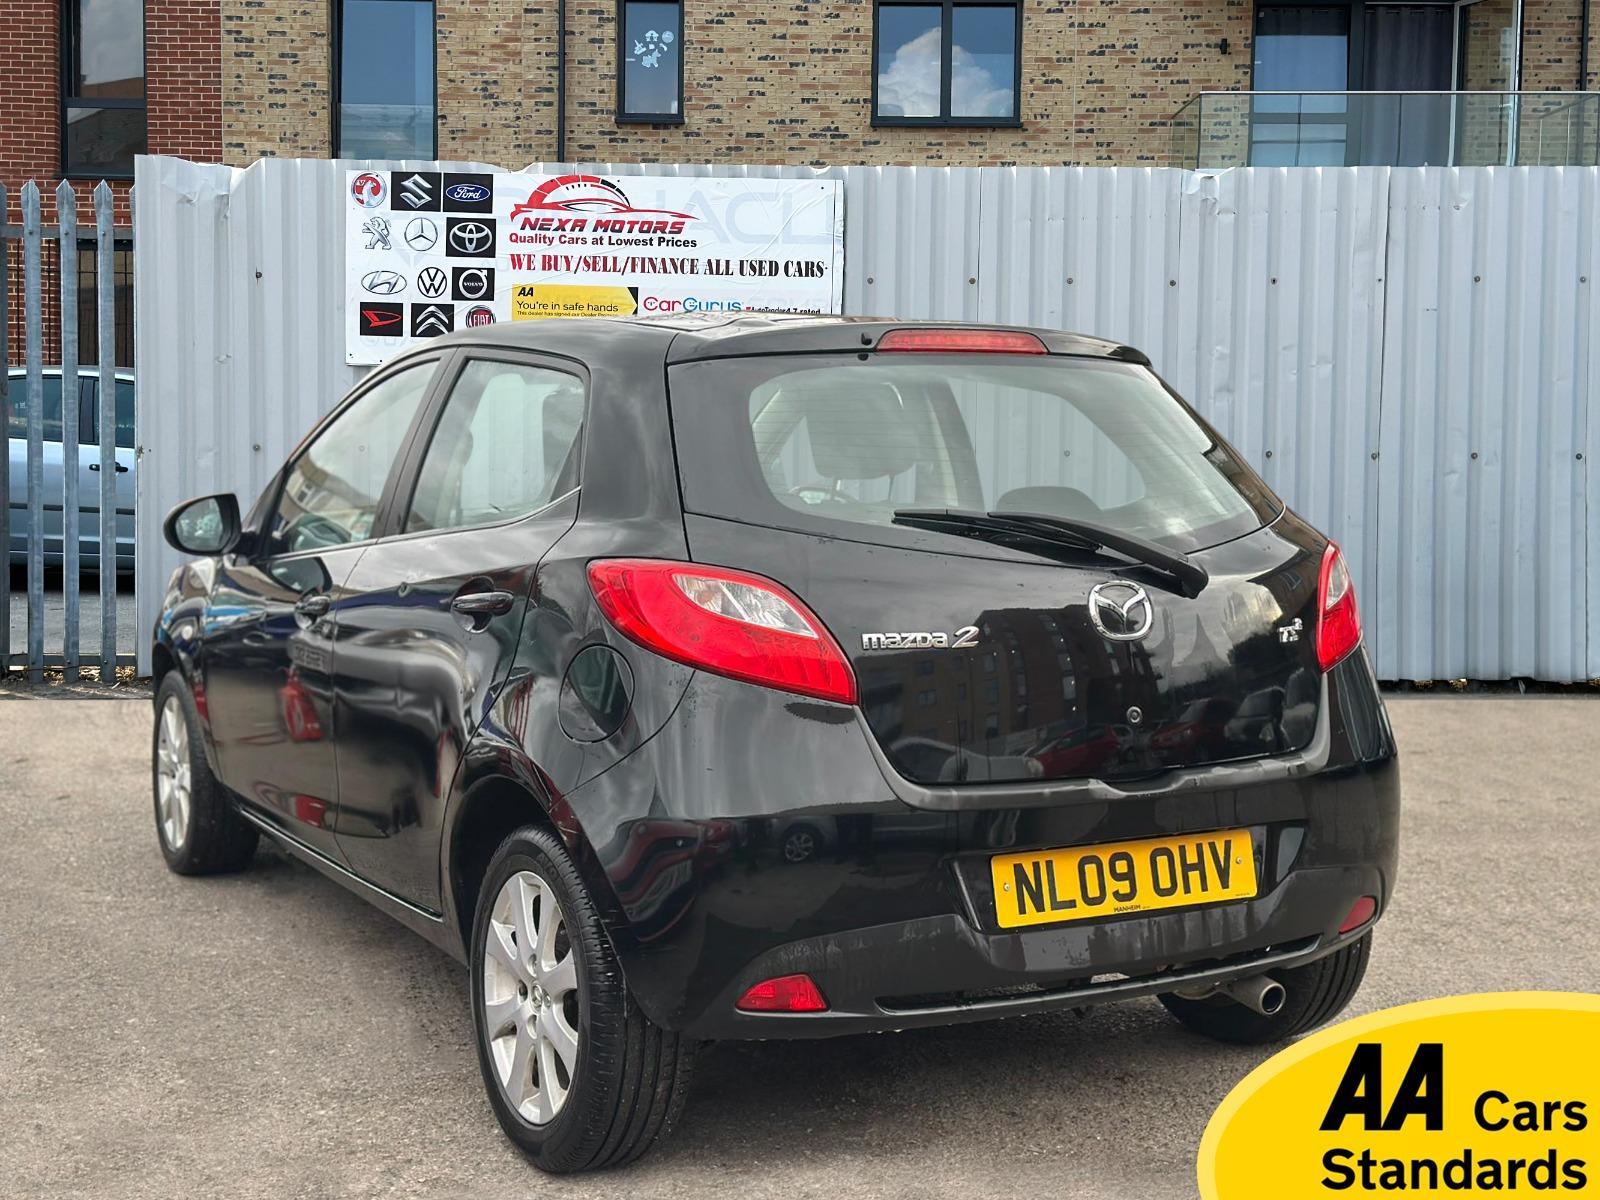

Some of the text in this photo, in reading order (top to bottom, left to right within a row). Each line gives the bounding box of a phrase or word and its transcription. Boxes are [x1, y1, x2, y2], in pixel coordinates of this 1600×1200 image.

[453, 186, 481, 199] Ford
[520, 217, 685, 234] NEXA MOTORS
[509, 232, 697, 248] Quality Cars at Lowest Prices
[508, 253, 825, 278] WE BUY/SELL/FINANCE ALL USED CARS
[517, 286, 534, 297] AA
[516, 301, 619, 312] You're in safe hands
[643, 296, 741, 311] CarGurus
[473, 315, 490, 327] FIAT
[951, 625, 980, 648] 2
[1013, 839, 1232, 915] NL09 OHV
[1113, 904, 1141, 912] MANHEIM
